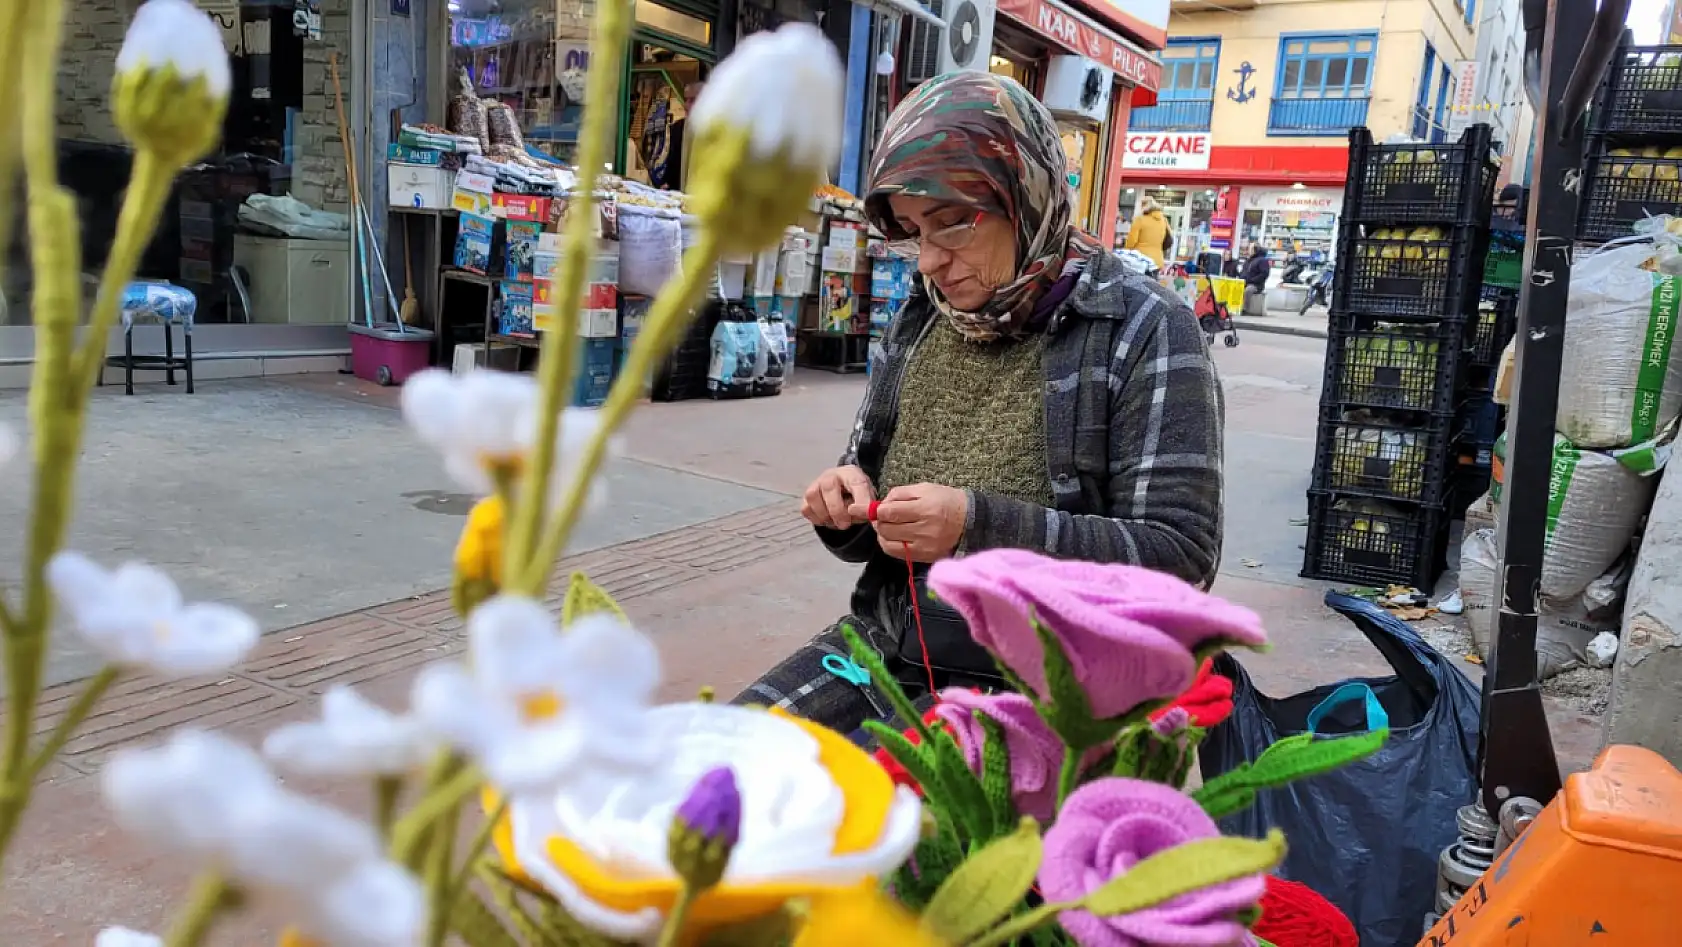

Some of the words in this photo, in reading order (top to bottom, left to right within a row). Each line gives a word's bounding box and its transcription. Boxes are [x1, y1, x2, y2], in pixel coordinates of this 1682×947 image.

[1039, 5, 1077, 44] NAR
[1124, 135, 1206, 154] CZANE
[1276, 196, 1332, 207] PHARMACY
[1648, 304, 1671, 369] MERCİMEK
